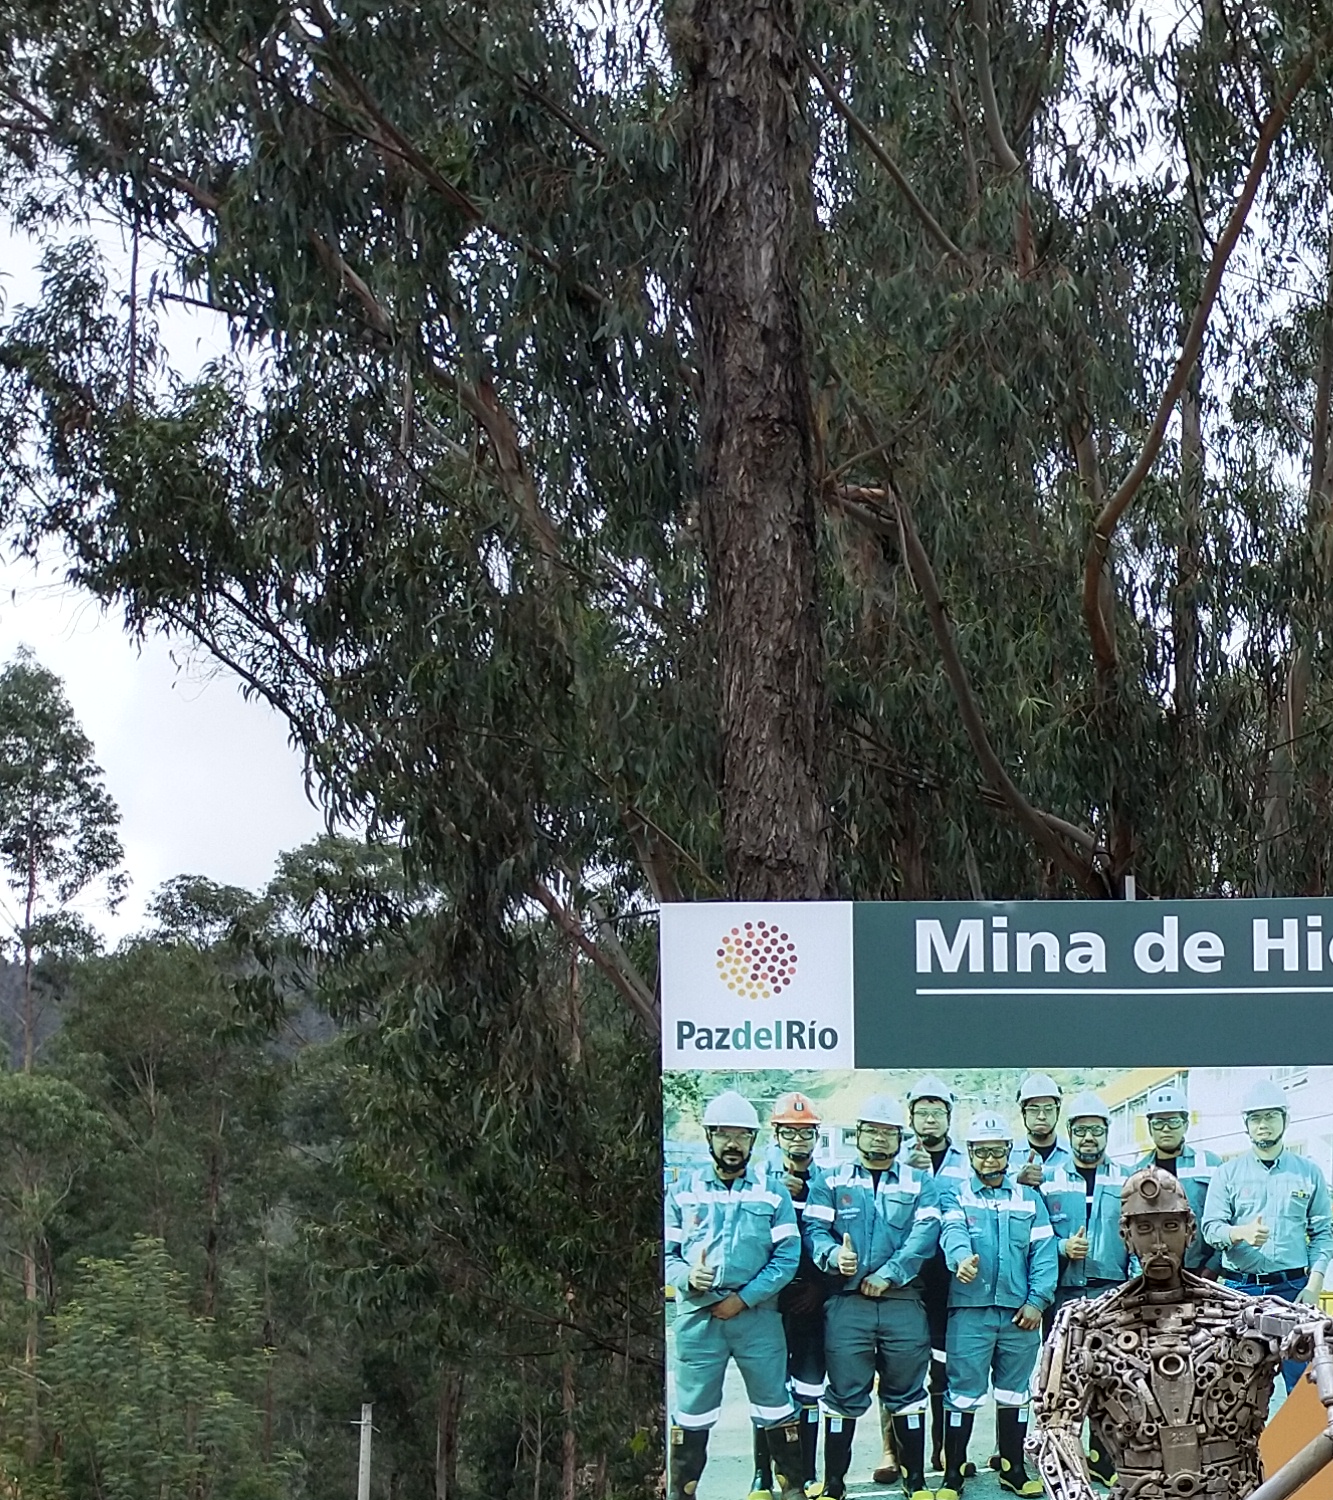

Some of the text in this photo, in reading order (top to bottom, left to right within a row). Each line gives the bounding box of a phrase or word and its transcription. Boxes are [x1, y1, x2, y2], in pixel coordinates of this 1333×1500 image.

[915, 916, 1106, 973] Mina
[1133, 916, 1225, 973] de
[676, 1020, 839, 1051] PazdelRío
